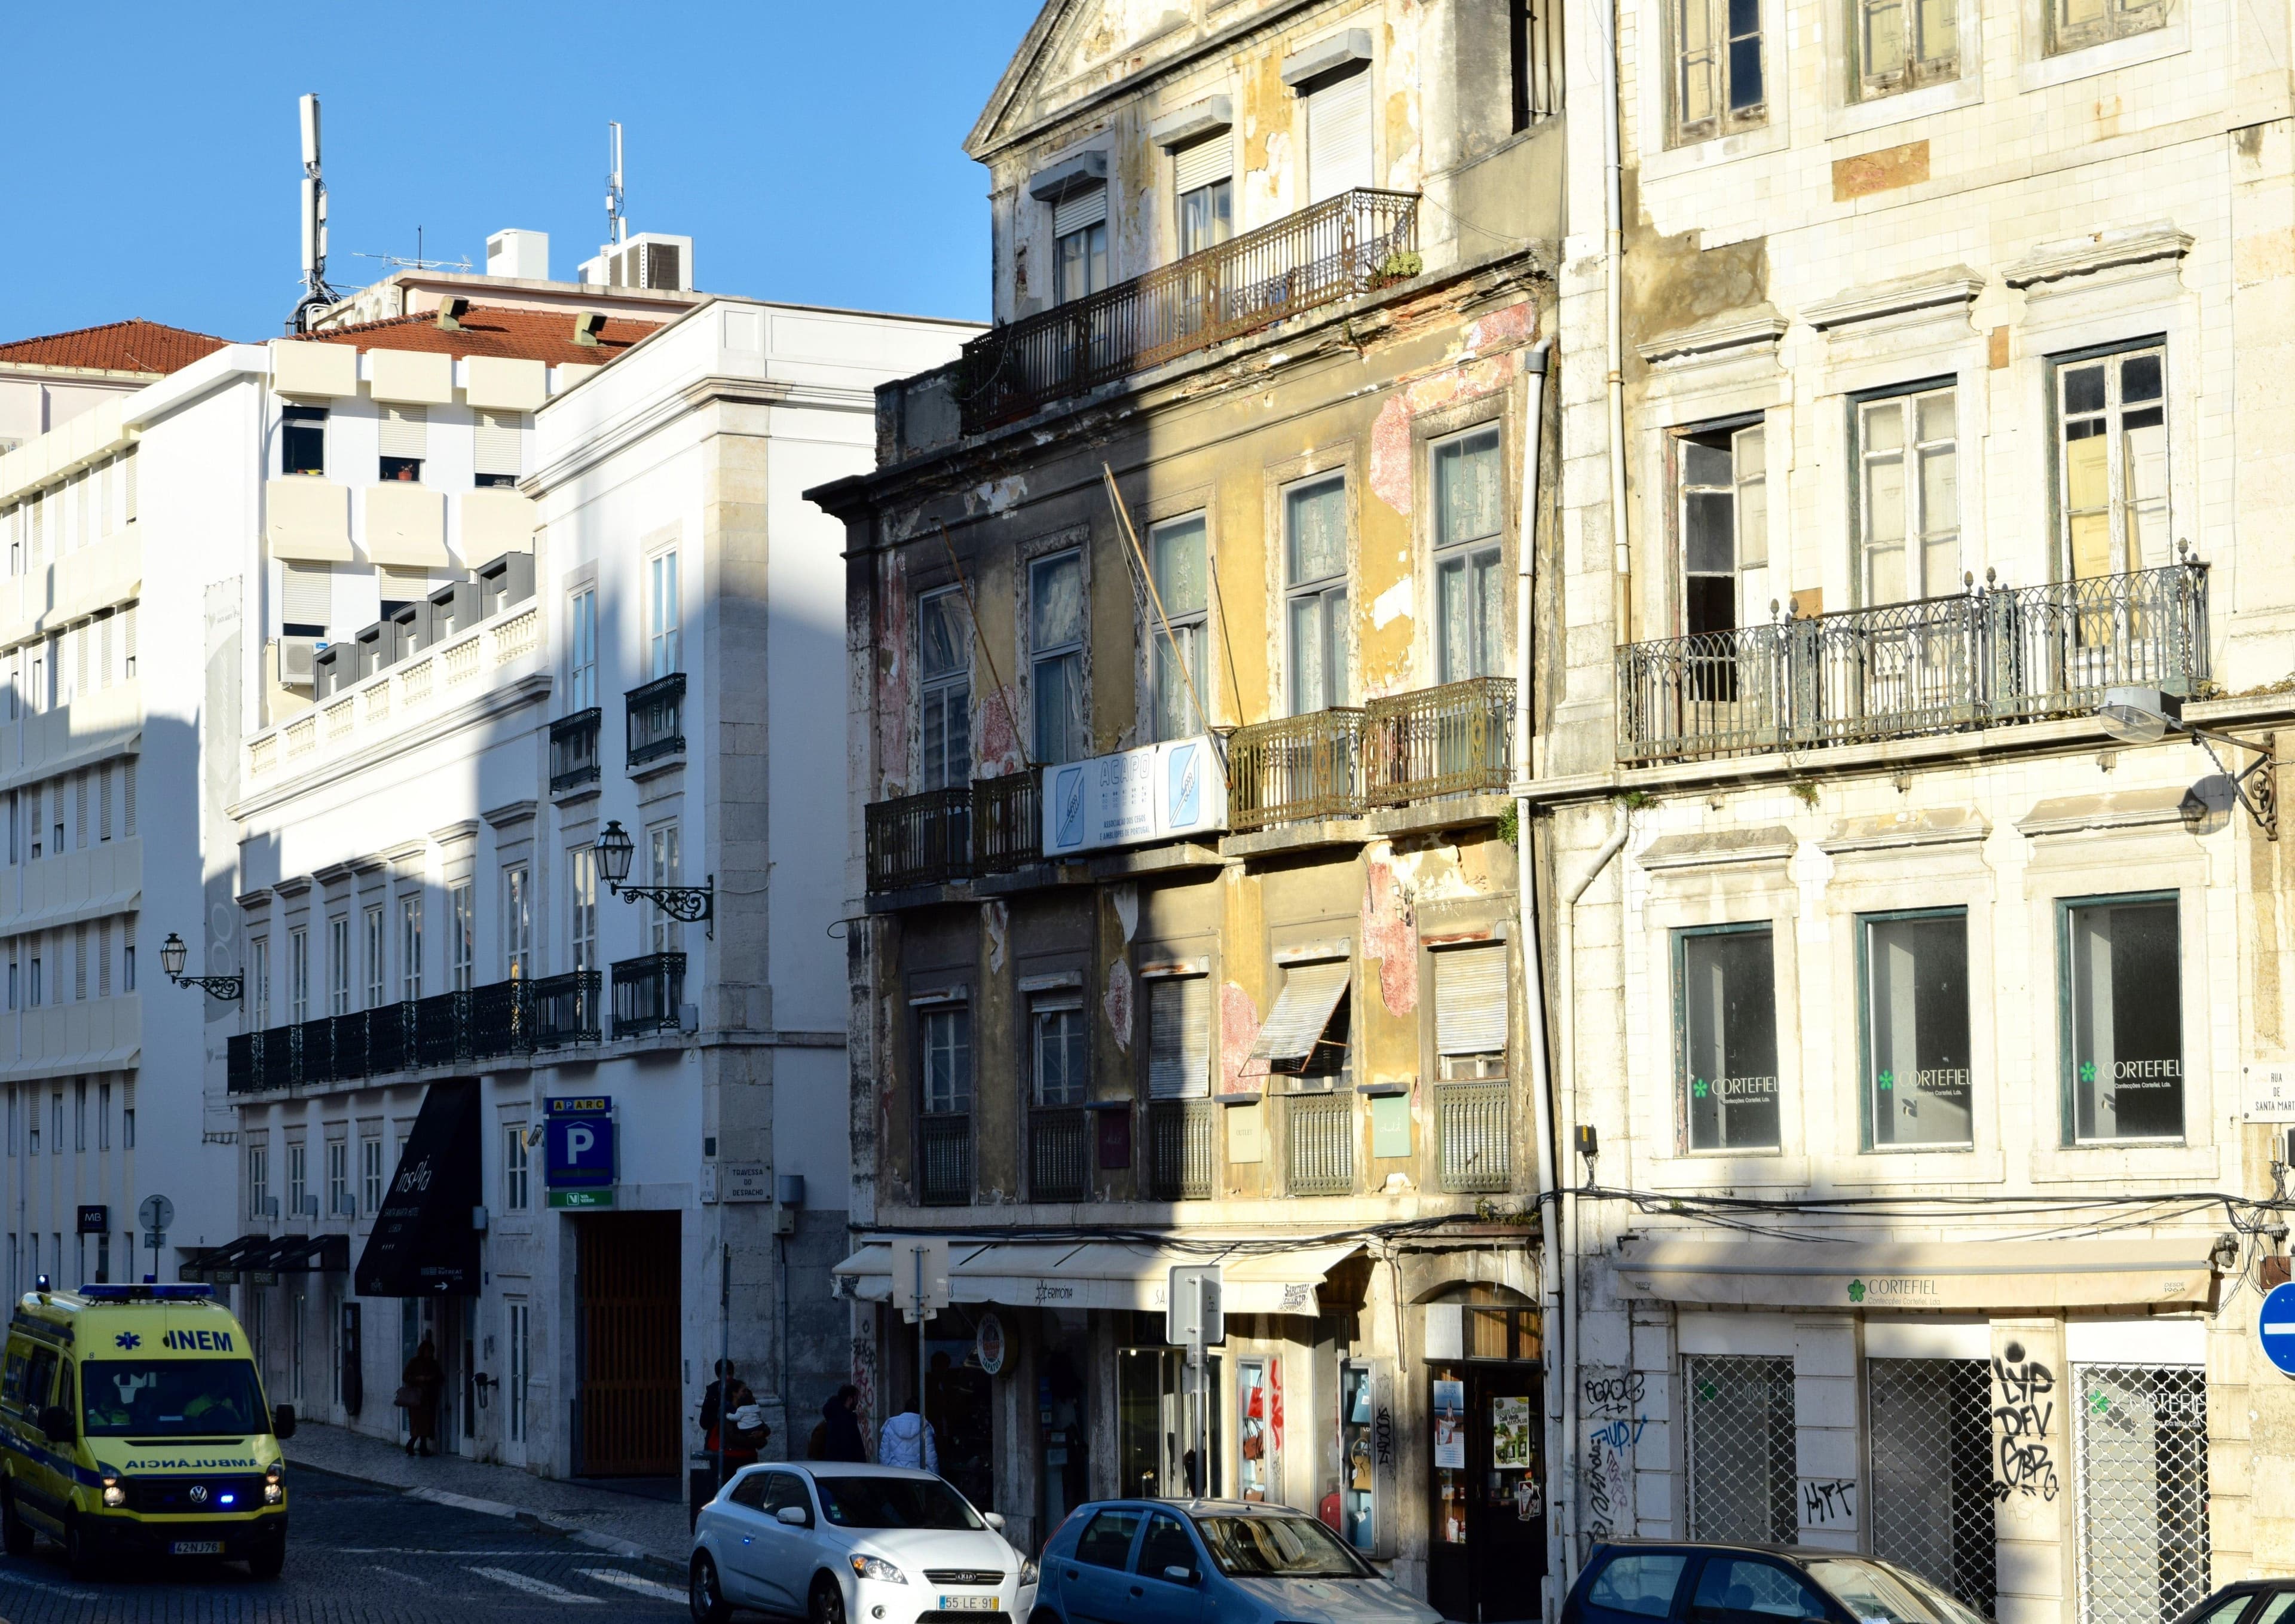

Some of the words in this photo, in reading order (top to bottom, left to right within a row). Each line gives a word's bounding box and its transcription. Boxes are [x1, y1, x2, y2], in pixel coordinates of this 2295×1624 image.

[1100, 753, 1149, 787] ACAPO
[1104, 817, 1125, 828] ASSOCIAÇÃO
[1134, 814, 1146, 823] CEGOS
[1130, 826, 1150, 836] PORTUGAL
[2101, 1059, 2182, 1079] CORTEFIEL
[1898, 1068, 1971, 1087] CORTEFIEL
[2270, 1073, 2282, 1083] RUA
[1712, 1076, 1779, 1095] CORTEFIEL
[2273, 1087, 2281, 1097] DE
[555, 1101, 604, 1110] APARC
[2256, 1101, 2275, 1111] SANTA
[567, 1127, 595, 1165] P
[84, 1213, 102, 1221] MB
[1869, 1279, 1938, 1295] CORTEFIEL
[1868, 1297, 1902, 1306] Confecções
[1929, 1297, 1942, 1306] Lda.
[169, 1330, 233, 1352] INEM
[982, 1358, 1002, 1372] SAPATOS
